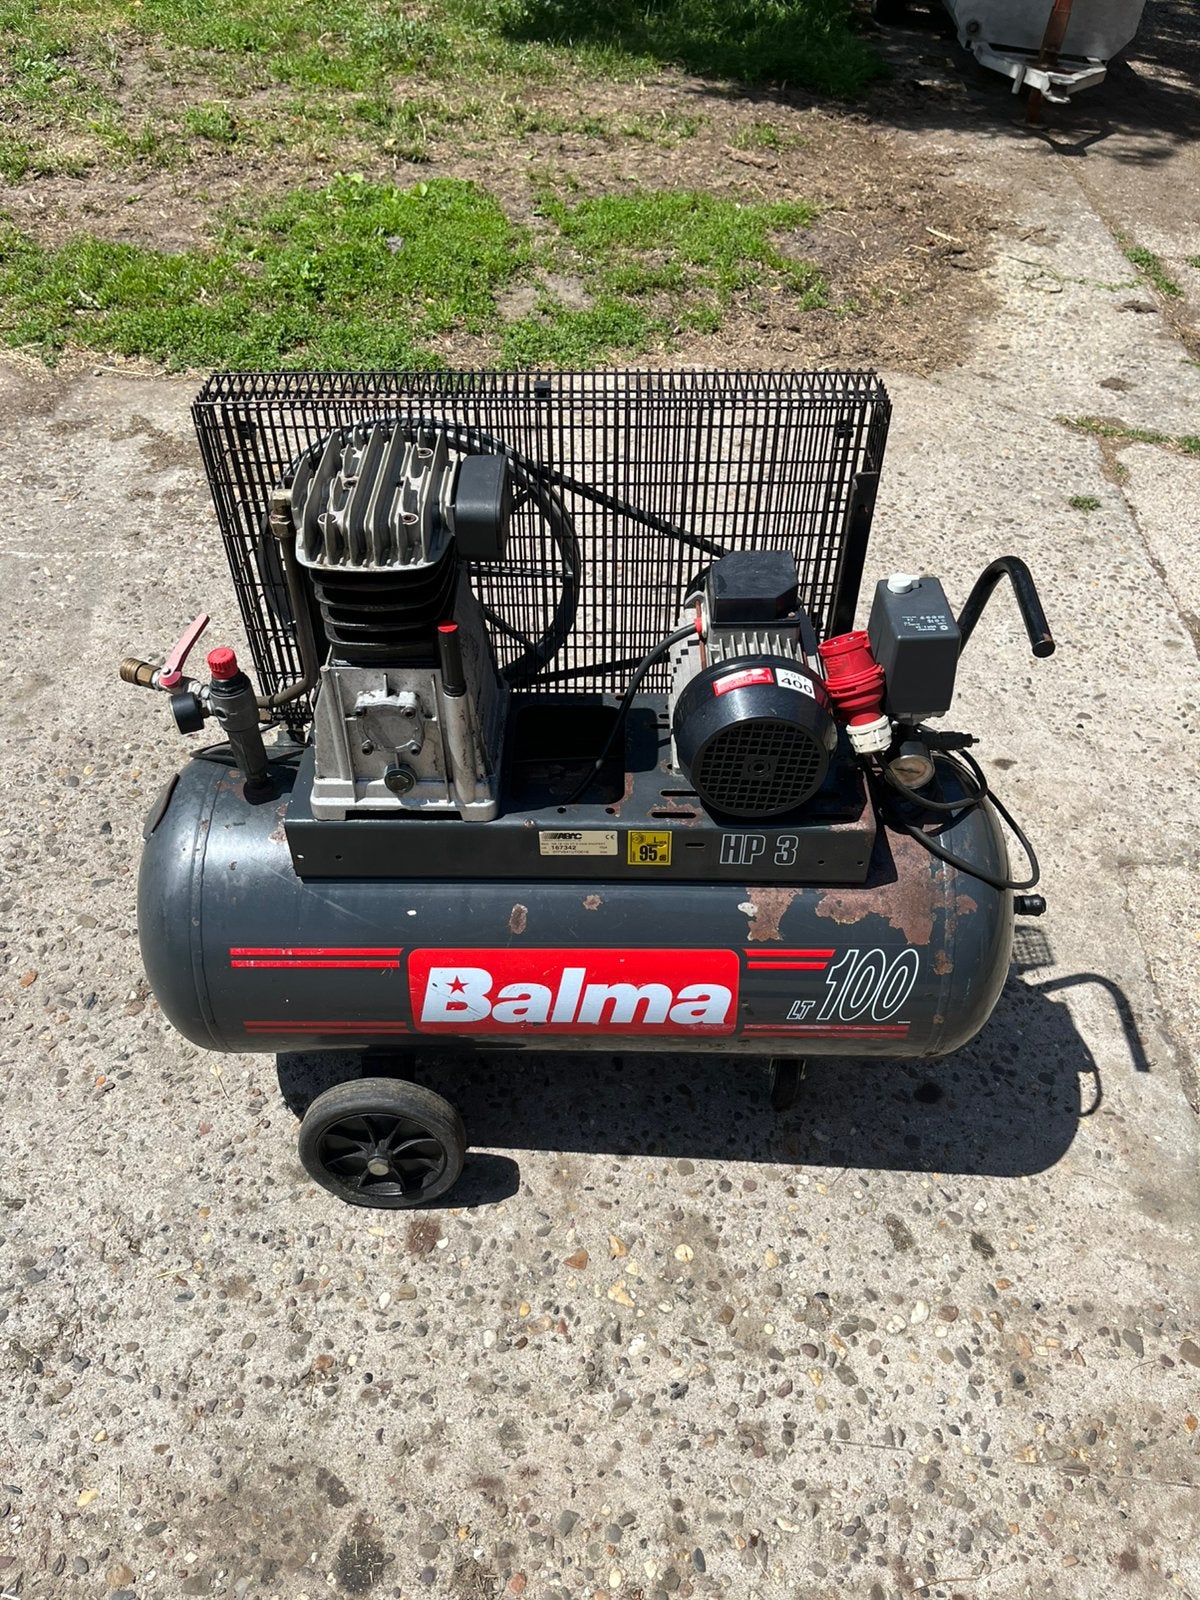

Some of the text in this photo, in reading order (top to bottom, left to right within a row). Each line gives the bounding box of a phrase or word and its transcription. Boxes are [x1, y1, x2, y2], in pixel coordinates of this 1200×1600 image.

[781, 677, 813, 694] 400
[639, 845, 658, 861] 95
[720, 834, 799, 866] HP 3
[421, 967, 733, 1024] Balma
[786, 948, 920, 1021] LT 100
